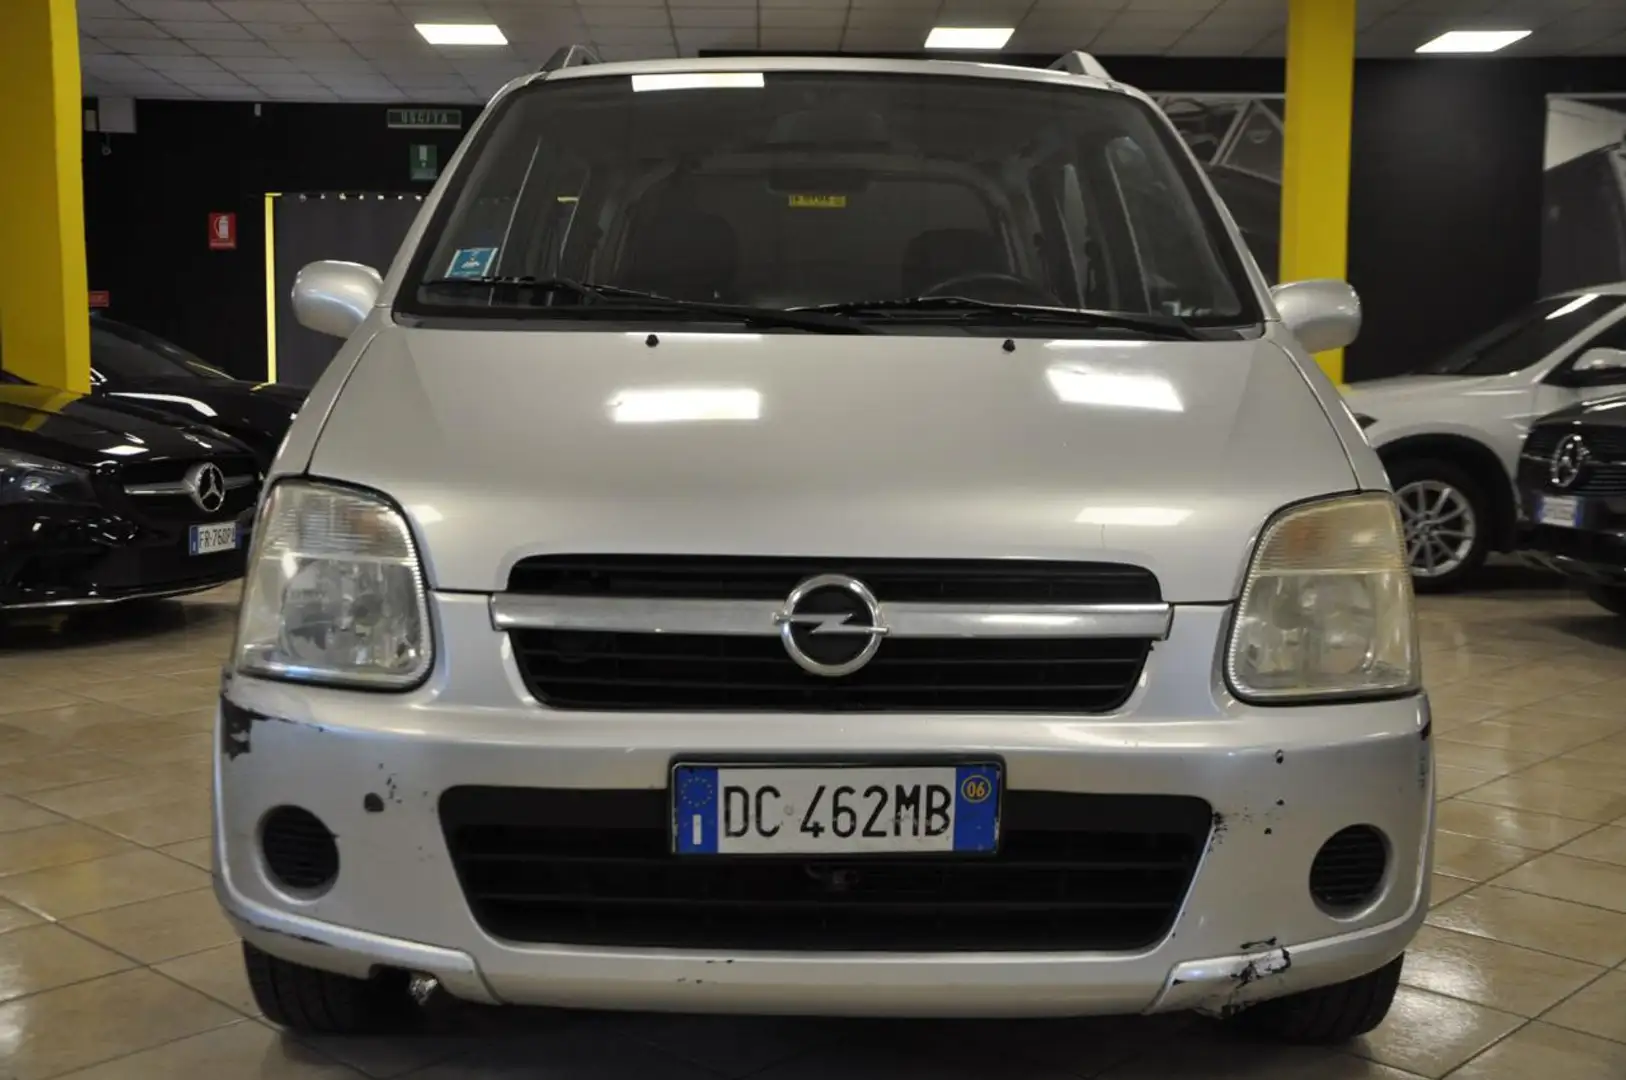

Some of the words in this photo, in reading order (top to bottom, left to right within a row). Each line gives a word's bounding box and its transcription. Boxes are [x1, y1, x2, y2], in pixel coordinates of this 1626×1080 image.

[401, 111, 448, 124] USCITA
[966, 781, 986, 797] 06
[723, 785, 781, 839] DC
[800, 784, 952, 839] 462MB
[692, 814, 703, 845] I
